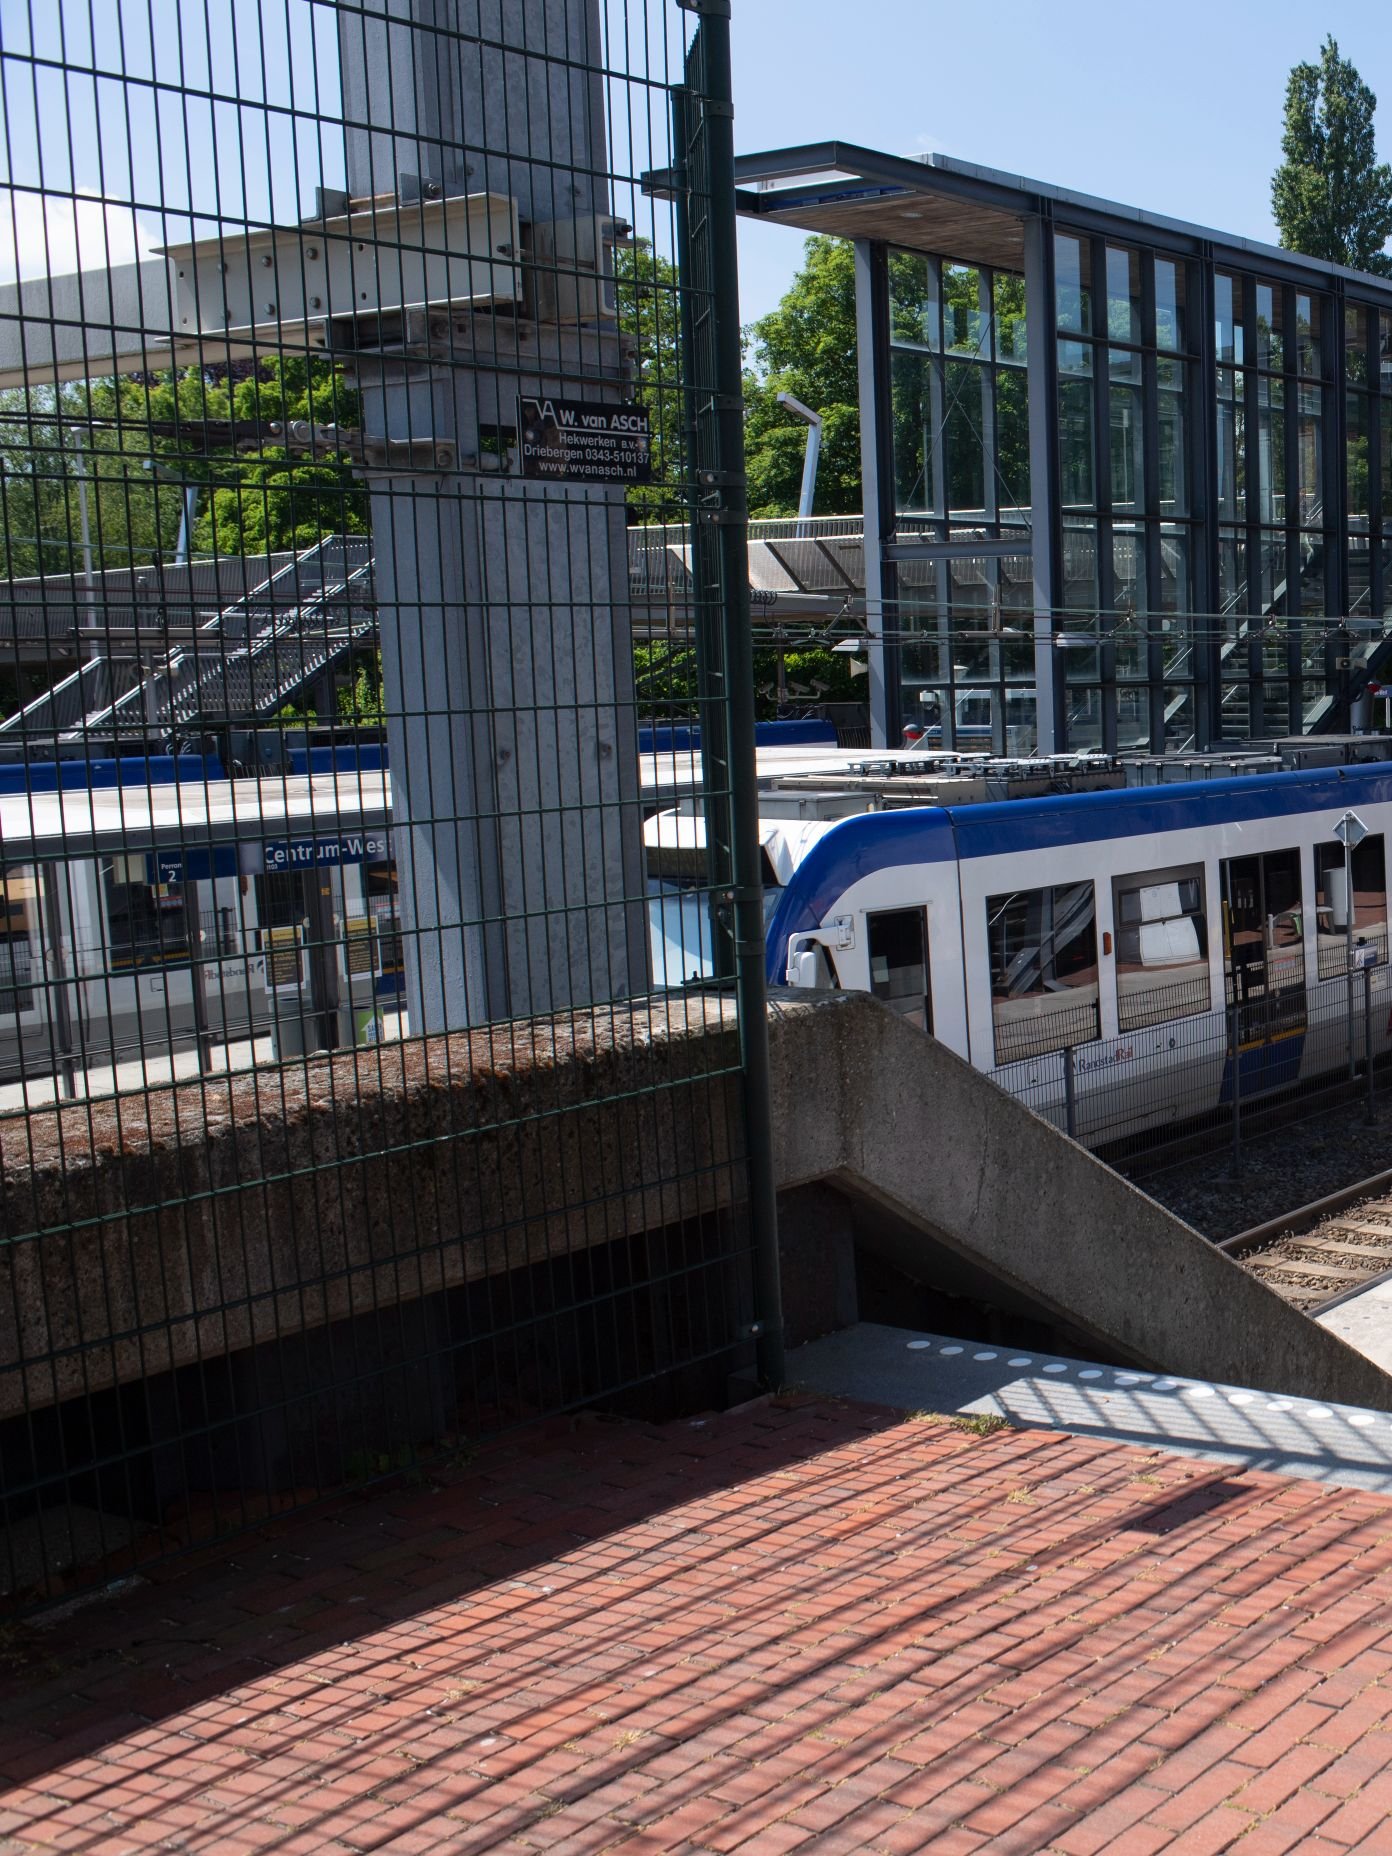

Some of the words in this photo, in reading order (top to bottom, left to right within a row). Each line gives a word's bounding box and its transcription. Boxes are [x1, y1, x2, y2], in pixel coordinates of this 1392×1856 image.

[560, 409, 578, 426] W.
[581, 415, 607, 429] van
[610, 414, 648, 432] ASCH
[559, 432, 617, 448] Hekwerken
[524, 444, 583, 462] Driebergen
[585, 449, 650, 464] 0343-510137
[538, 461, 637, 477] www.wvanasch.nl
[168, 870, 177, 882] 2
